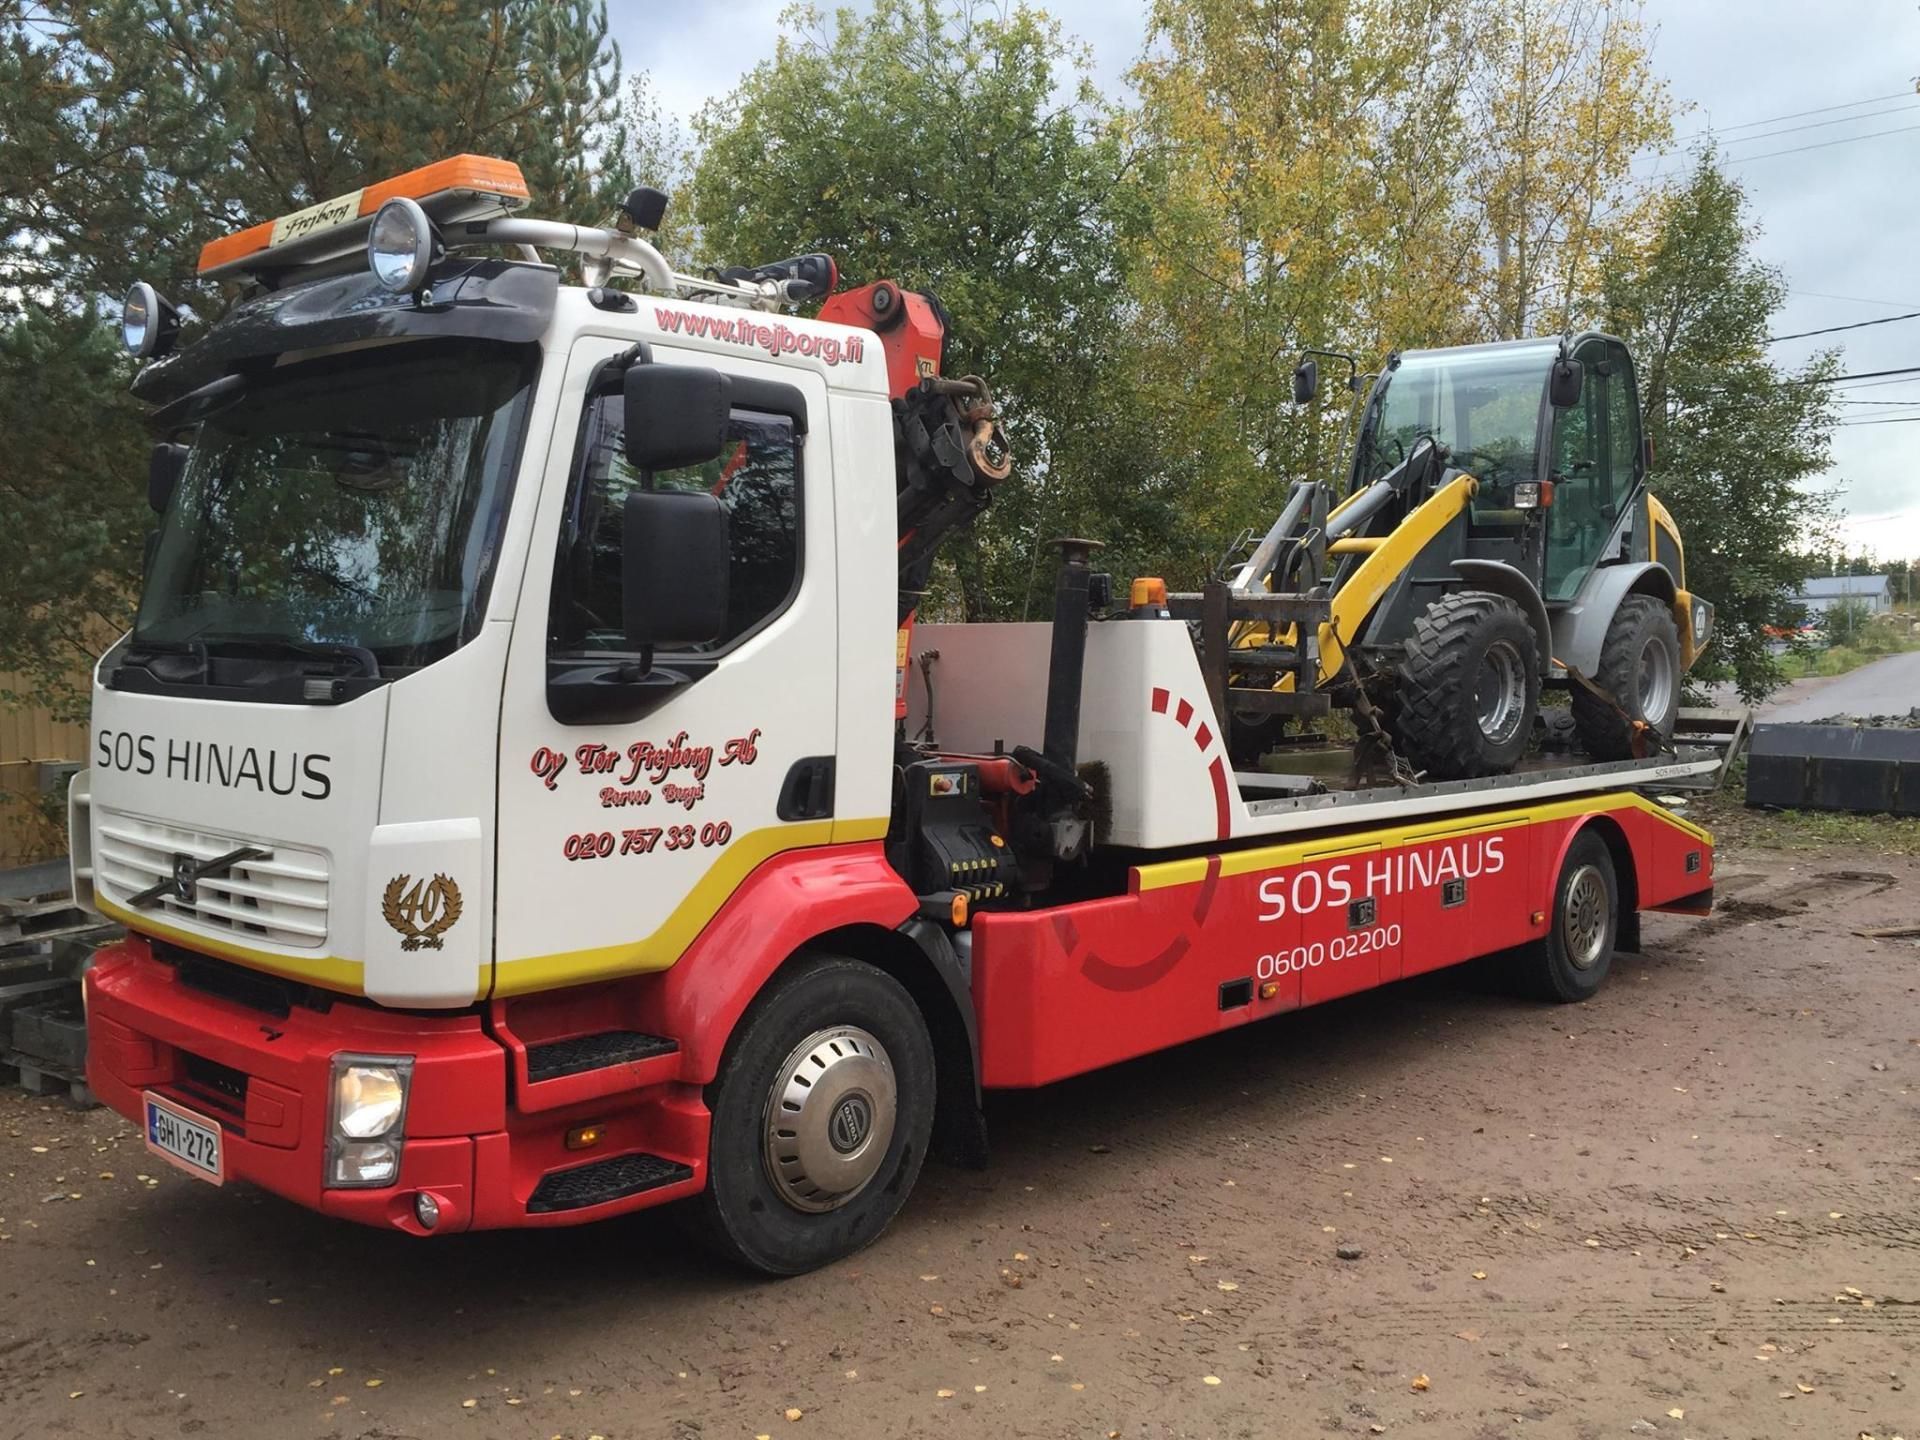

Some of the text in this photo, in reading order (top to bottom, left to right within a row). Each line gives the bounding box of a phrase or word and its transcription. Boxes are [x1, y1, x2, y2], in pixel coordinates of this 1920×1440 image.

[278, 202, 350, 243] Frejborg
[654, 307, 864, 366] www.frejborg.fi
[97, 729, 332, 800] SOS HINAUS
[530, 728, 761, 791] Oy Tor Frejborg Ab
[600, 786, 652, 808] Porvoo
[563, 820, 732, 861] 020 757 33 00
[399, 878, 441, 923] 40
[1258, 836, 1504, 922] SOS HINAUS
[1257, 923, 1402, 980] 0600 02200
[159, 1114, 215, 1168] GHI-272
